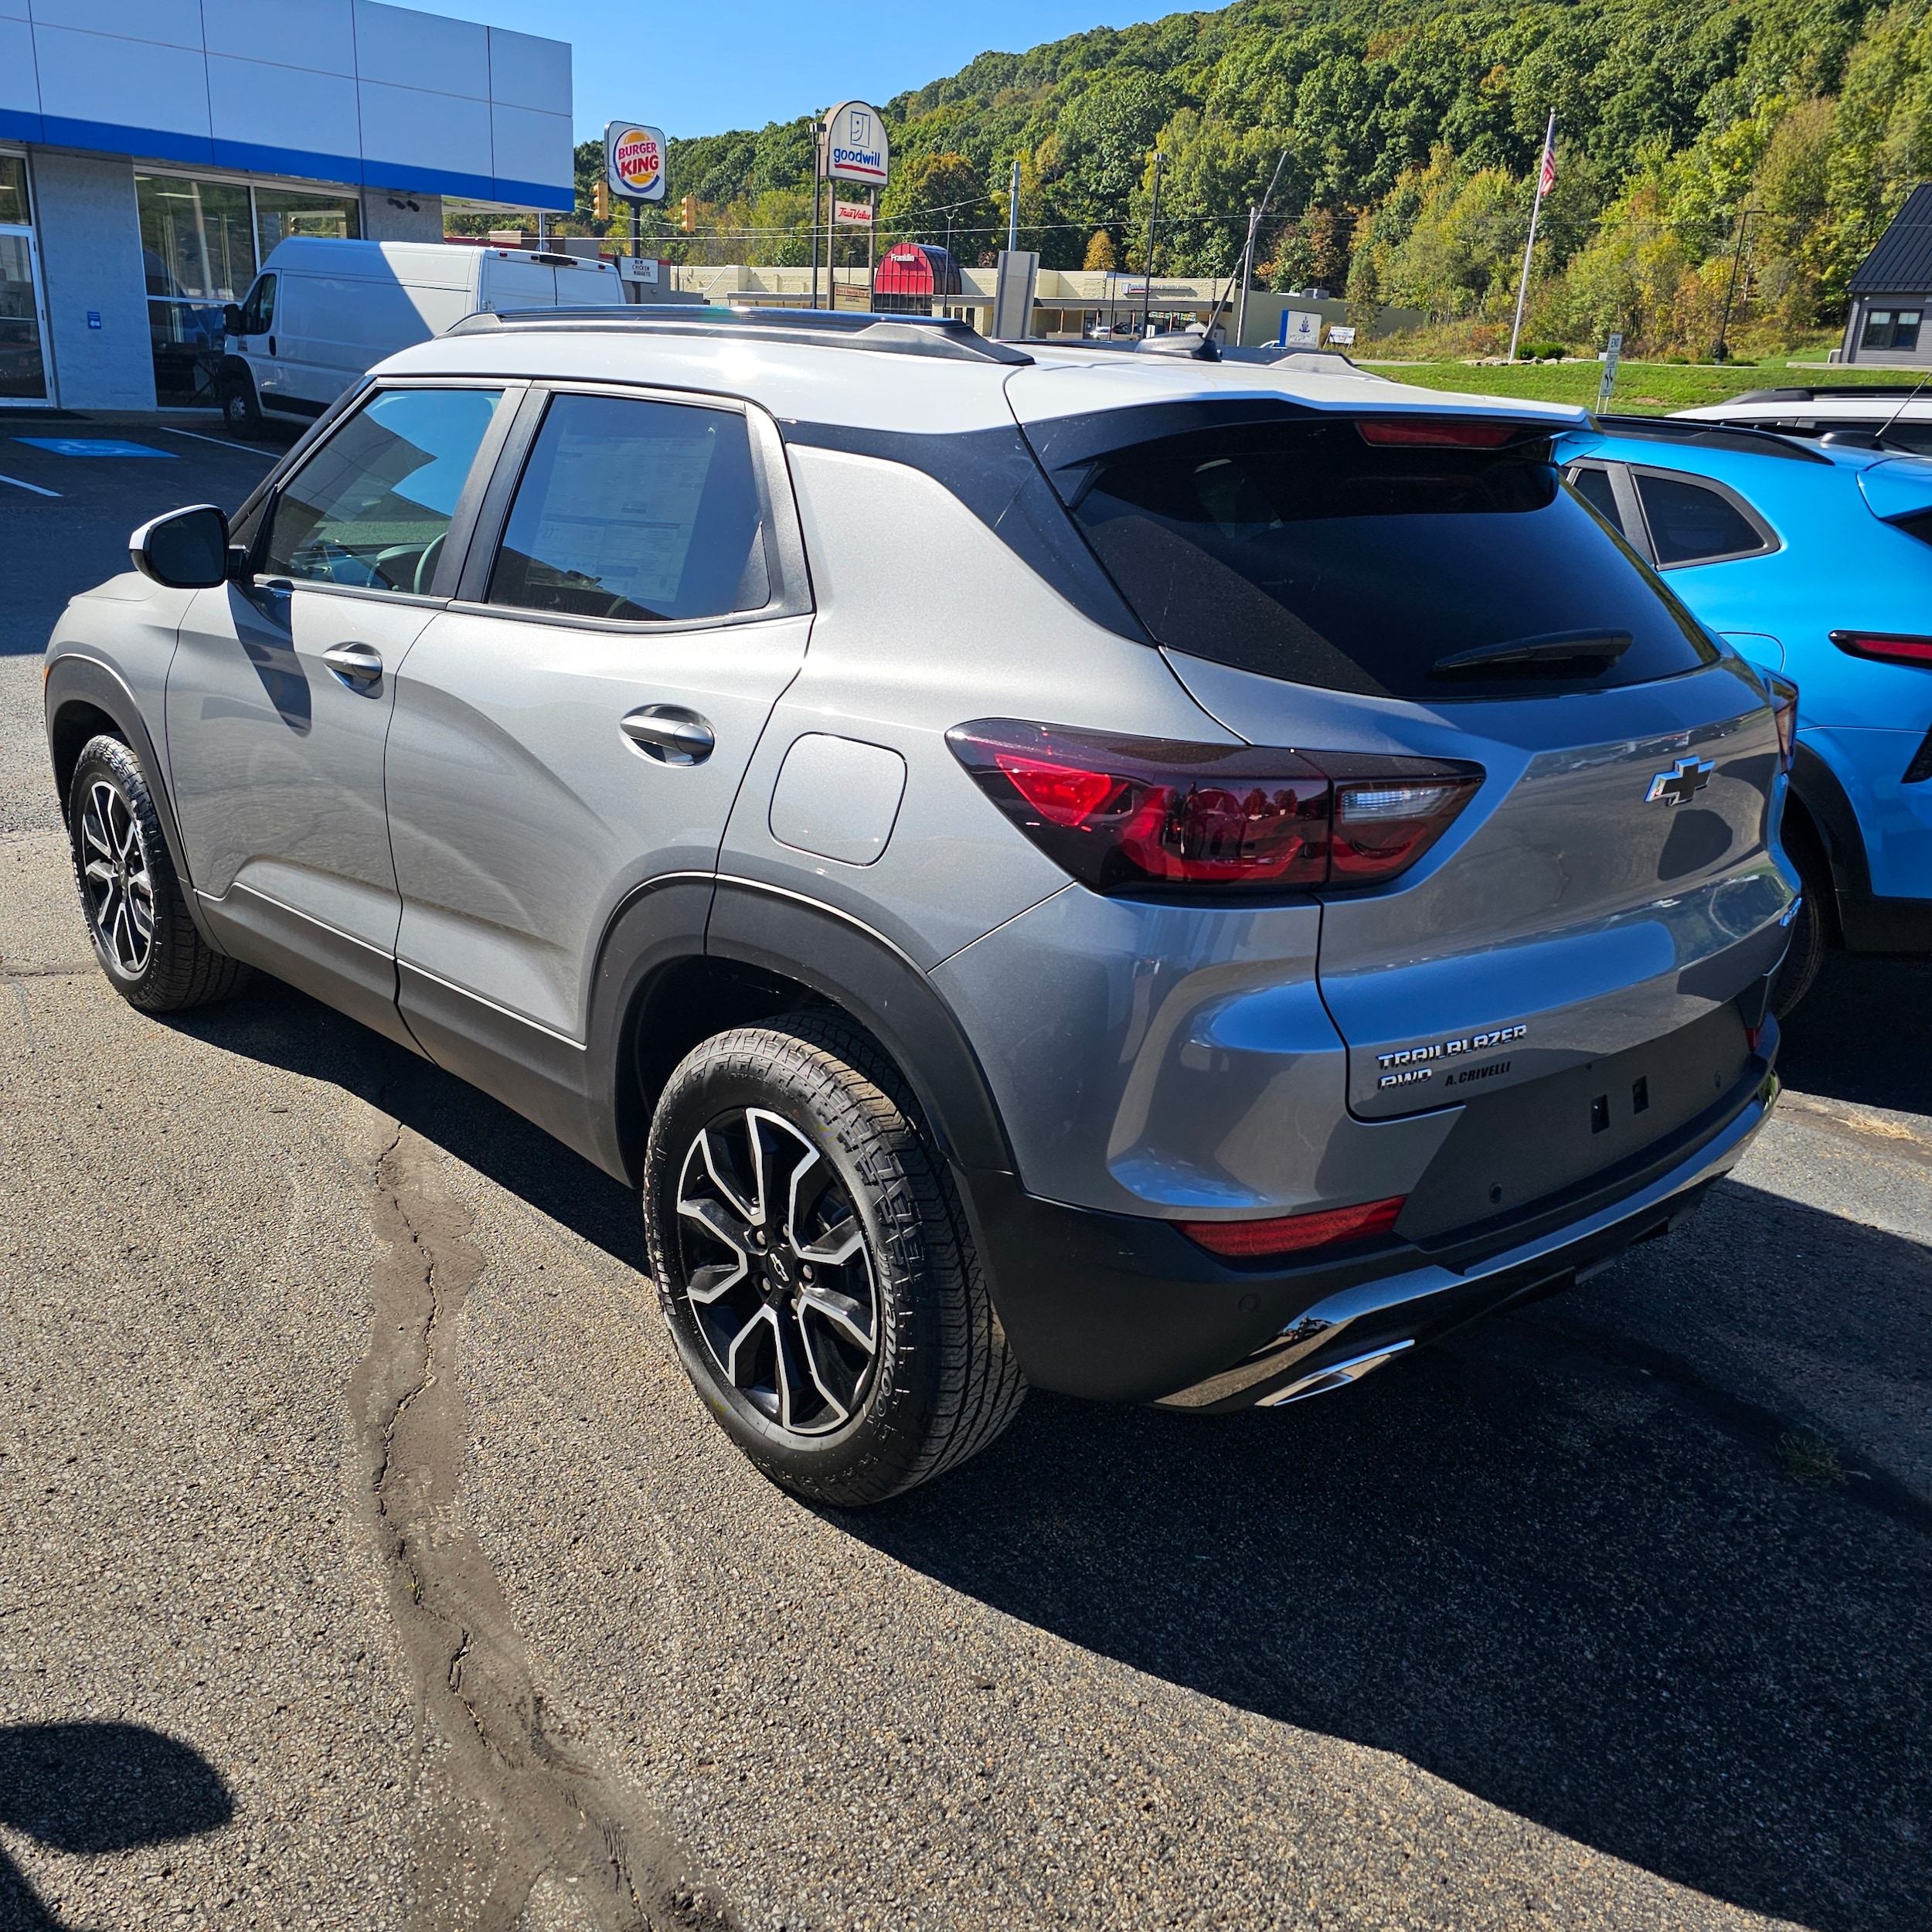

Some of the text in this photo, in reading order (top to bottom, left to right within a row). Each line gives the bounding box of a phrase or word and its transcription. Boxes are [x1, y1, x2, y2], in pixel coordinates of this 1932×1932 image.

[618, 142, 656, 160] BURGER
[834, 148, 880, 167] goodwill
[621, 155, 658, 178] KING
[891, 253, 915, 262] Franklin
[1611, 338, 1620, 348] END
[1377, 1025, 1527, 1069] TRAILBLAZER
[1379, 1068, 1432, 1089] AWD
[1445, 1061, 1512, 1087] A. CRIVELLI
